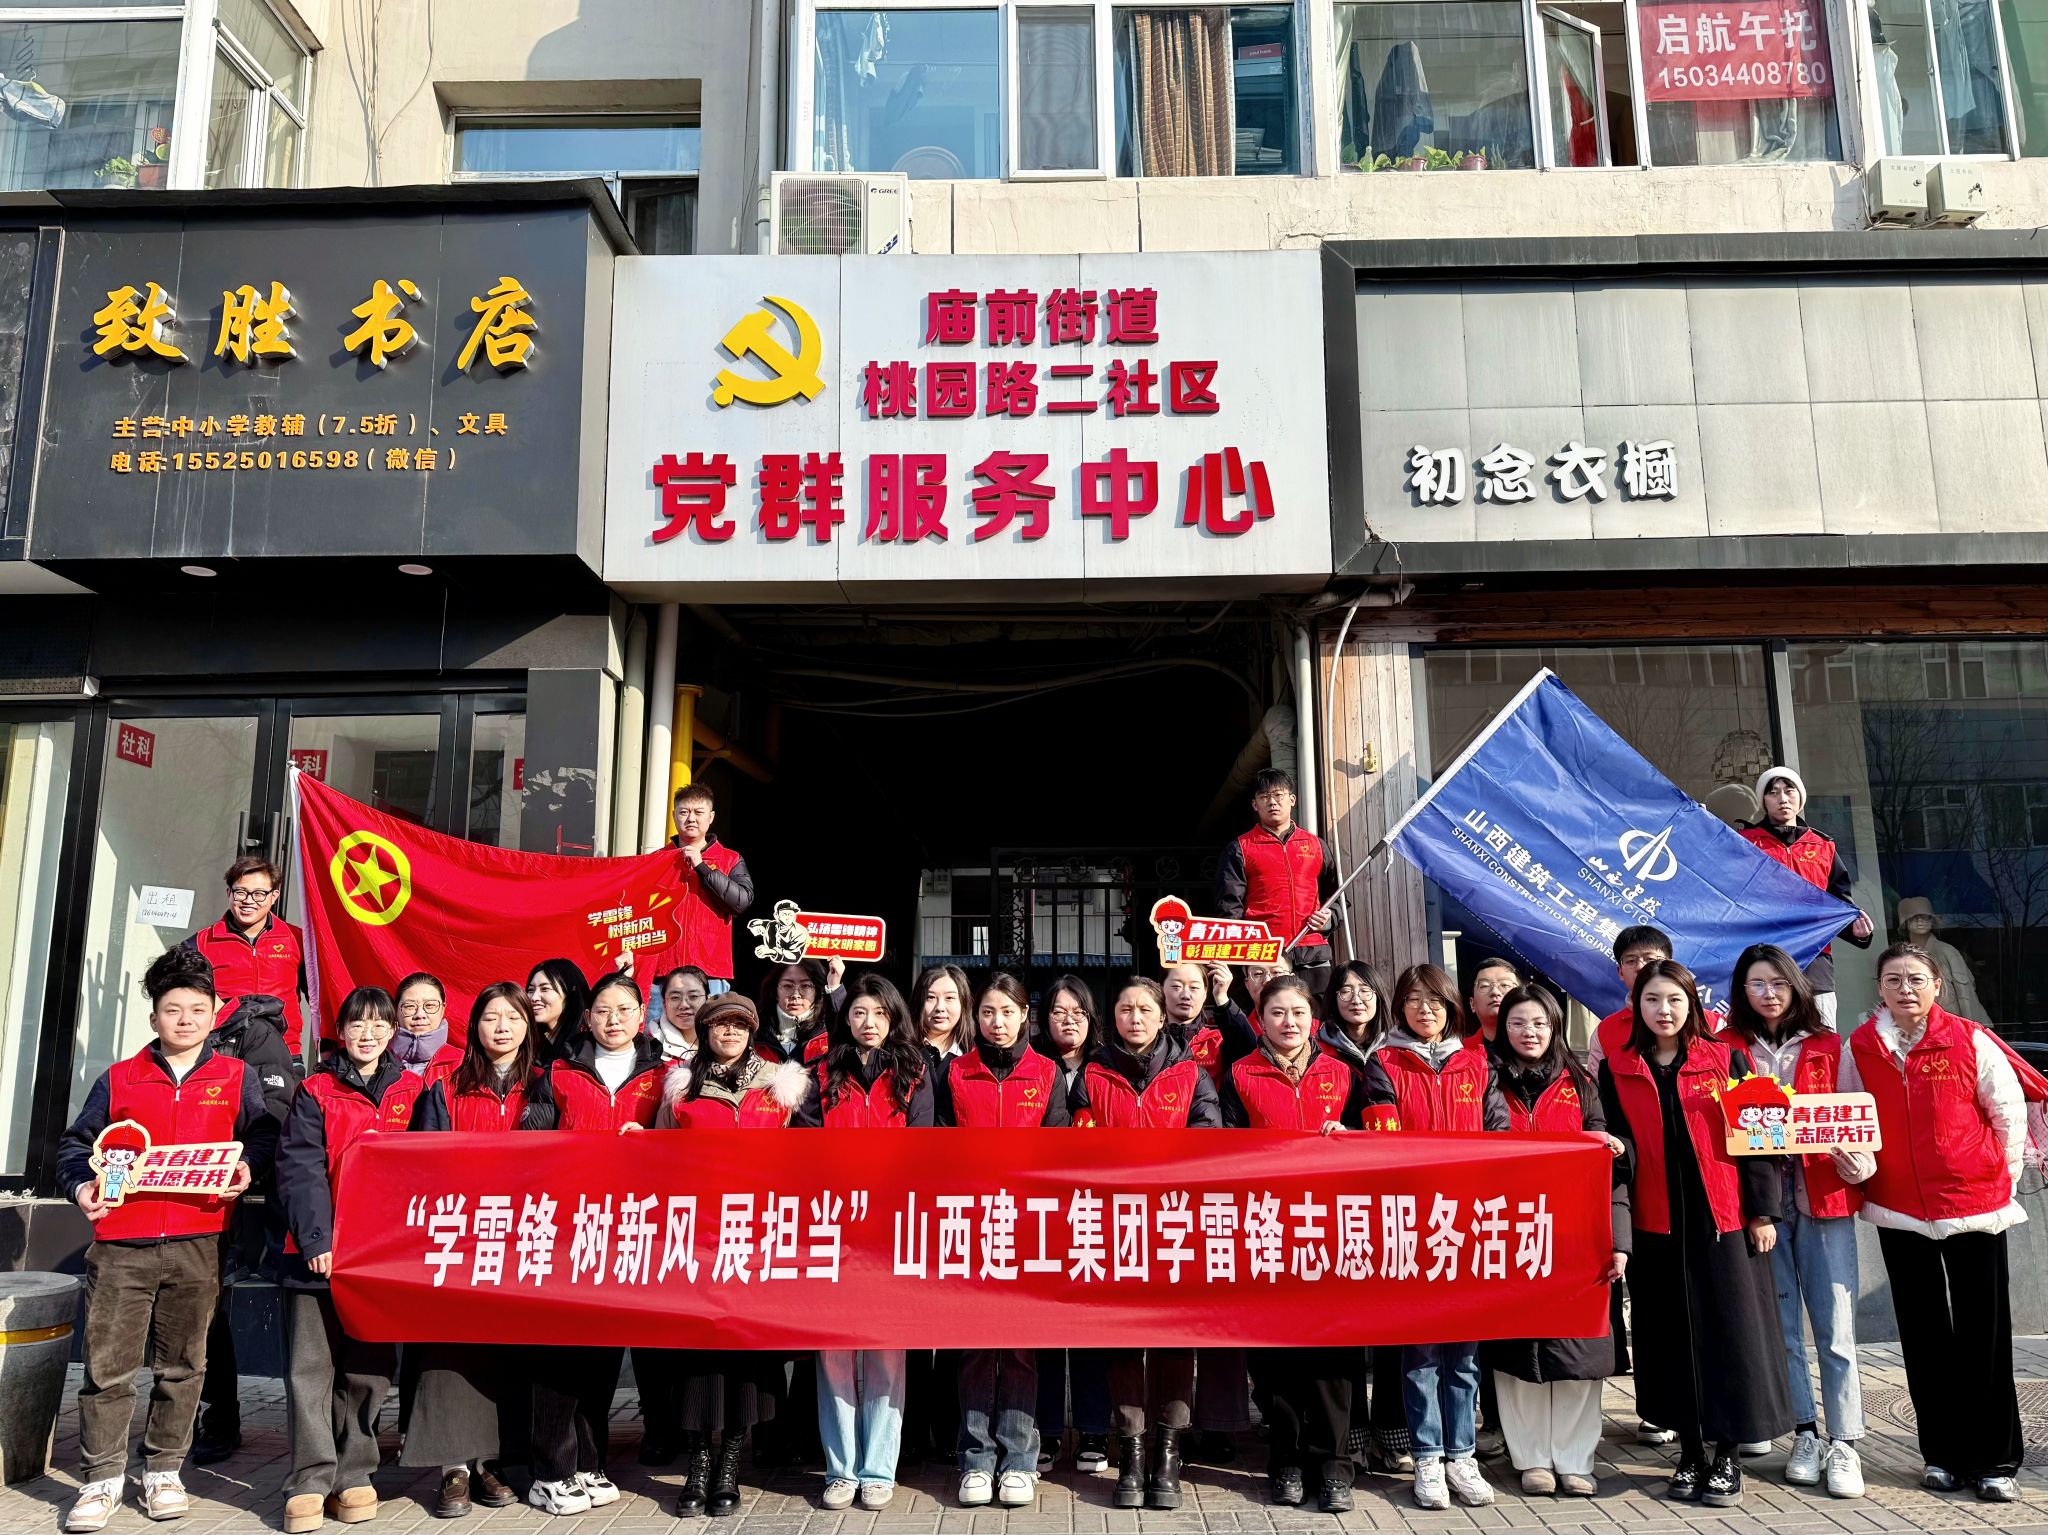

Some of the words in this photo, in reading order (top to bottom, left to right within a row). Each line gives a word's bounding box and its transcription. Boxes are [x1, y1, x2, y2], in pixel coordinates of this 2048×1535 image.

[1656, 9, 1817, 55] 启航午托
[1658, 61, 1826, 89] 15034408780
[92, 276, 537, 372] 致胜书店
[925, 287, 1160, 346] 庙前街道
[863, 359, 1221, 418] 桃园路二社区
[1410, 439, 1680, 502] 初念衣橱
[651, 446, 1276, 542] 党群服务中心
[121, 730, 151, 762] 社科
[1452, 827, 1491, 863] SHANXI
[1488, 861, 1571, 929] CONSTRUCTION
[147, 892, 177, 905] 出租
[1577, 867, 1622, 906] SHANXI
[1622, 903, 1649, 926] CIG
[587, 905, 633, 927] 学雷锋
[608, 916, 654, 939] 树新风
[621, 929, 667, 952] 展担当
[1188, 921, 1262, 940] 青力青为
[1185, 942, 1278, 961] 彰显建工责任
[1792, 1104, 1874, 1124] 青春建工
[1795, 1125, 1876, 1144] 志愿先行
[143, 1147, 237, 1167] 青春建工
[136, 1168, 229, 1188] 志愿有我
[406, 1192, 558, 1288] “学雷锋
[570, 1192, 699, 1286] 树新风
[711, 1190, 868, 1284] 展担当”
[893, 1188, 1553, 1284] 山西建工集团学雷锋志愿服务活动
